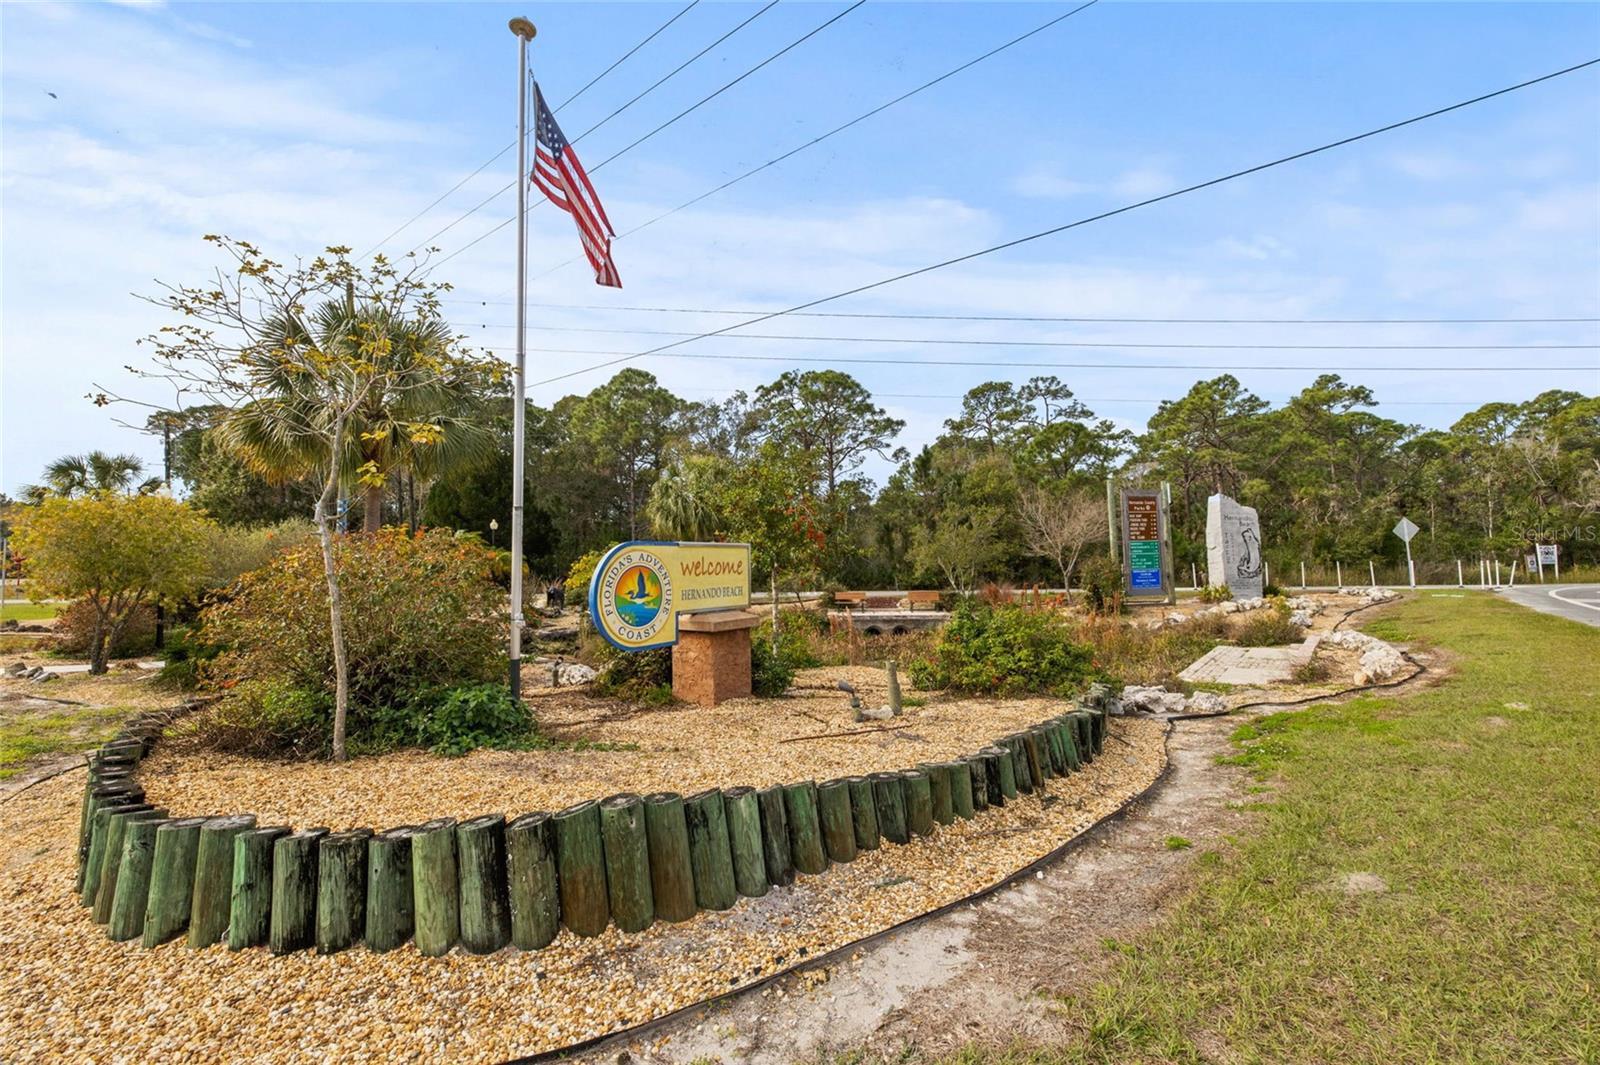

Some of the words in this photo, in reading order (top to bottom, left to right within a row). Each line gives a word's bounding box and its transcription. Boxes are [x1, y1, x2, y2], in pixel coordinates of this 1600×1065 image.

[680, 556, 744, 577] welcome
[603, 554, 633, 617] FLORIDA'S
[639, 553, 673, 616] ADVENTURE
[681, 587, 721, 601] HERNANDO
[722, 585, 744, 598] BEACH
[618, 624, 658, 641] COAST
